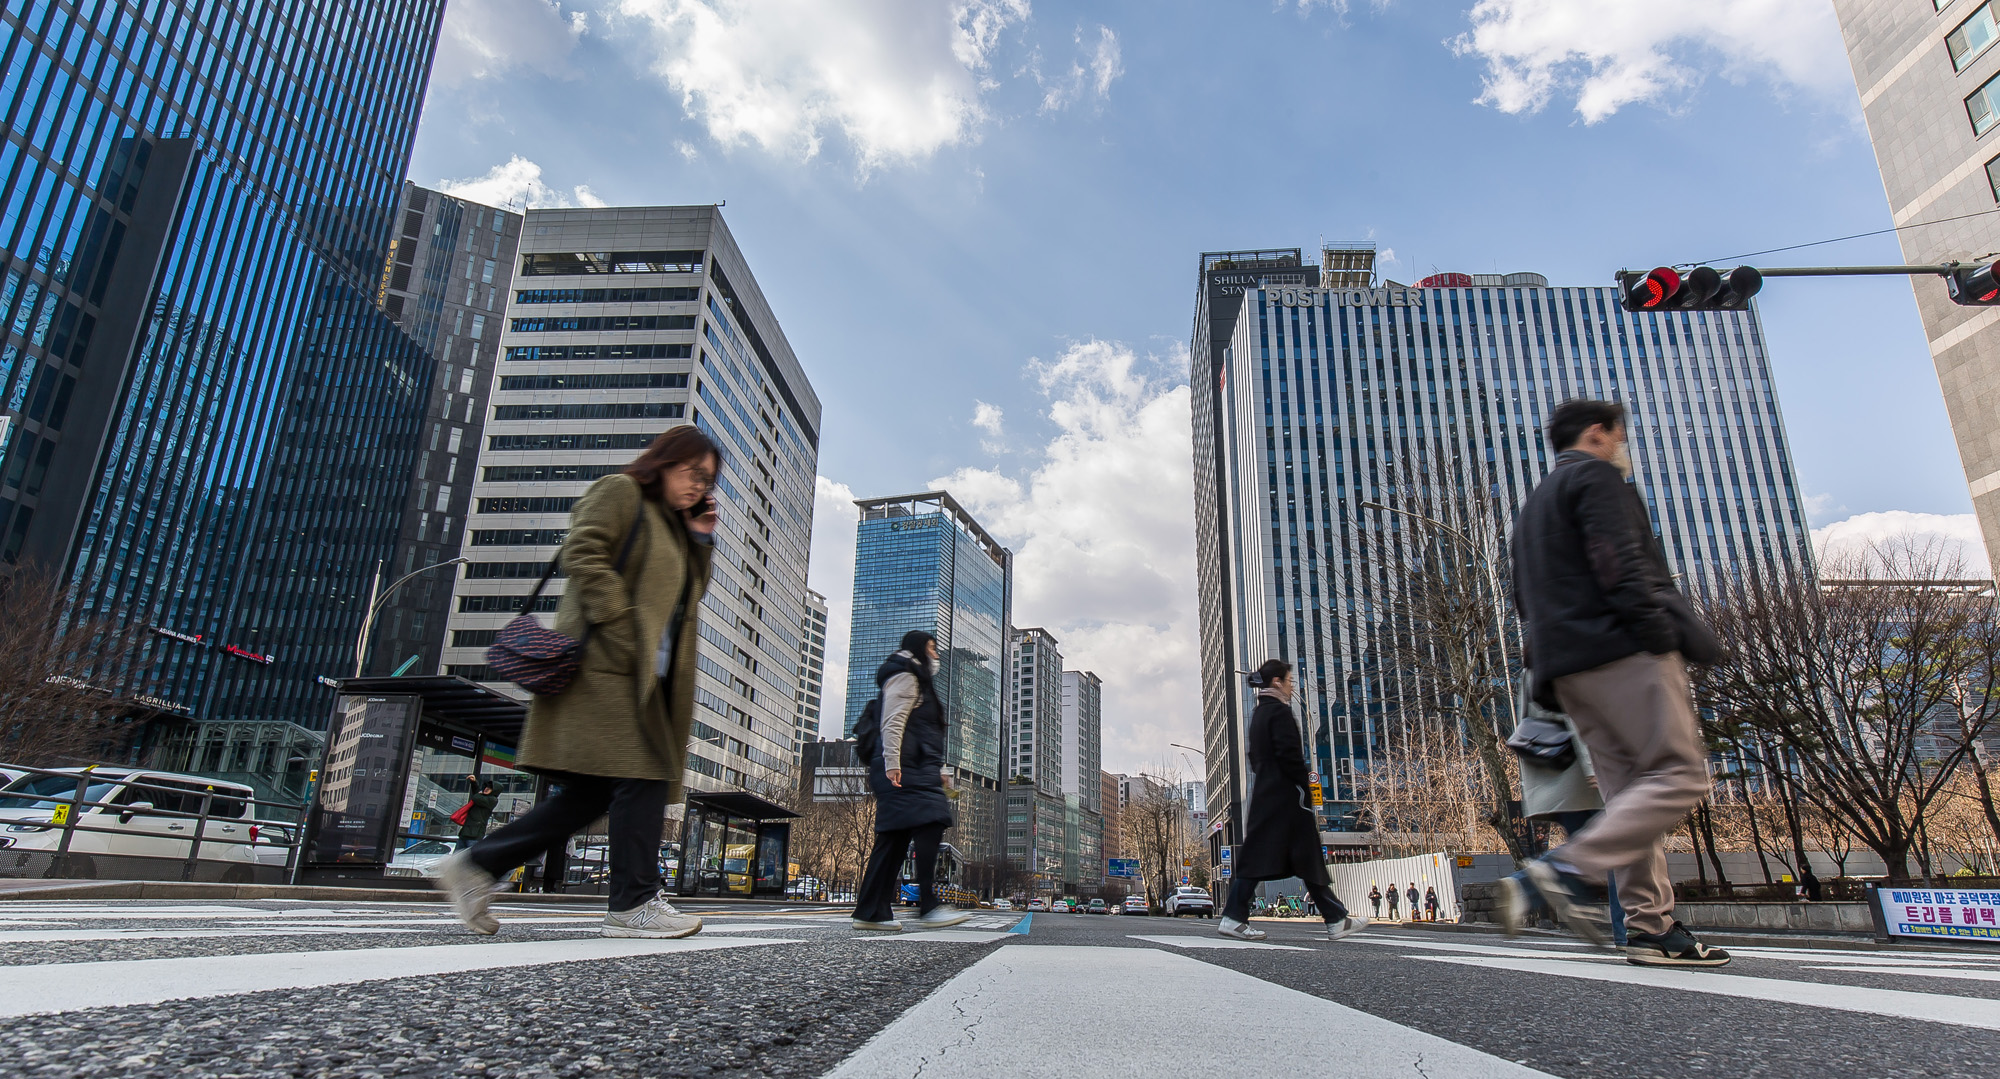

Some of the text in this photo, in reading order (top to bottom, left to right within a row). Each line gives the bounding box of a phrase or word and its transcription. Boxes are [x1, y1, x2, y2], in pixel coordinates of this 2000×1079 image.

[1214, 275, 1256, 285] SHILLA
[1221, 286, 1248, 295] STAY
[1266, 288, 1422, 308] POST TOWER
[159, 628, 197, 643] ASIANA AIRLINES
[134, 693, 181, 710] LAGRILLIA
[1892, 891, 2000, 906] 에이원짐 마포 공덕역점
[1905, 906, 1996, 925] 트리플 혜택
[1932, 926, 1948, 935] 누릴
[1949, 927, 1957, 935] 수
[1971, 928, 1988, 937] 파격
